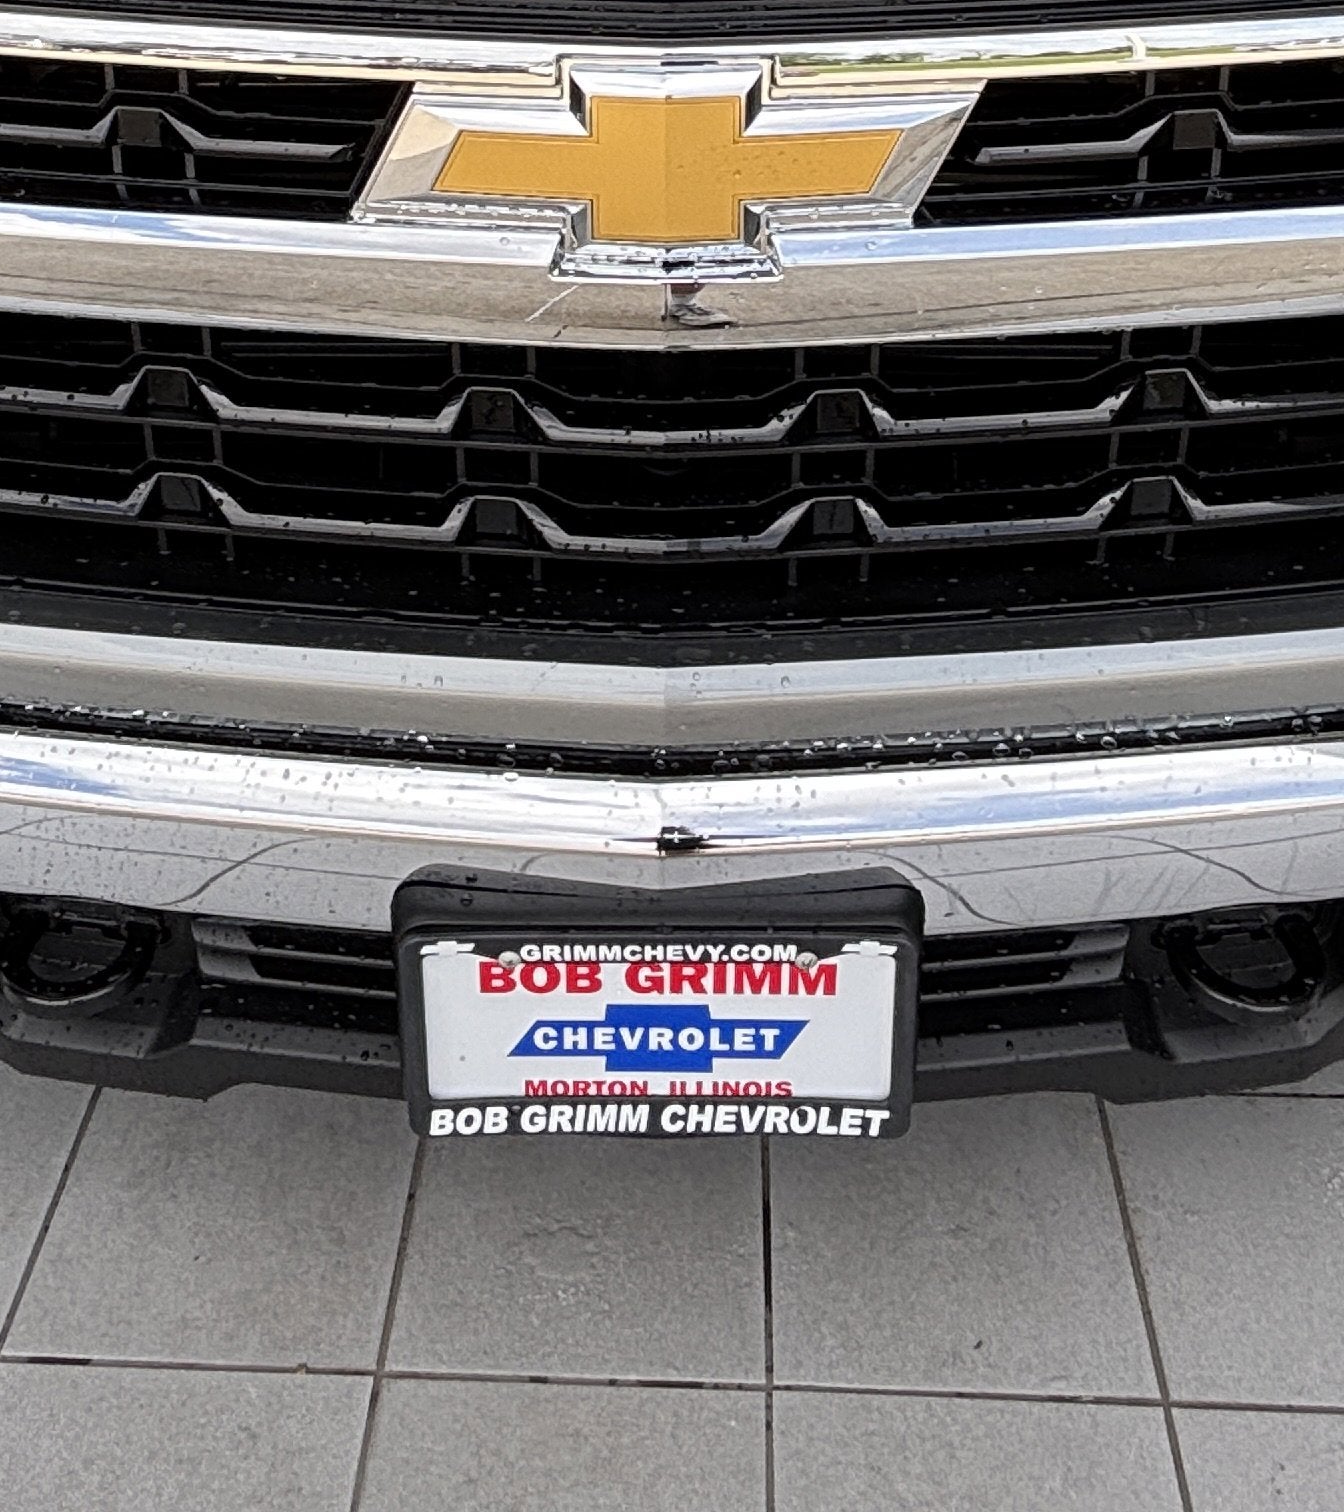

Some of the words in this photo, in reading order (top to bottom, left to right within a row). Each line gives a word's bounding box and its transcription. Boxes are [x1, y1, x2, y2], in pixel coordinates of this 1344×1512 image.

[519, 944, 798, 962] GRIMMCHEVY.COM
[479, 961, 603, 994] BOB
[624, 962, 838, 995] GRIMM
[533, 1026, 781, 1051] CHEVROLET
[524, 1080, 649, 1097] MORTON
[669, 1080, 794, 1097] ILLINOIS
[429, 1106, 509, 1136] BOB
[519, 1104, 651, 1134] GRIMM
[660, 1104, 891, 1137] CHEVROLET
